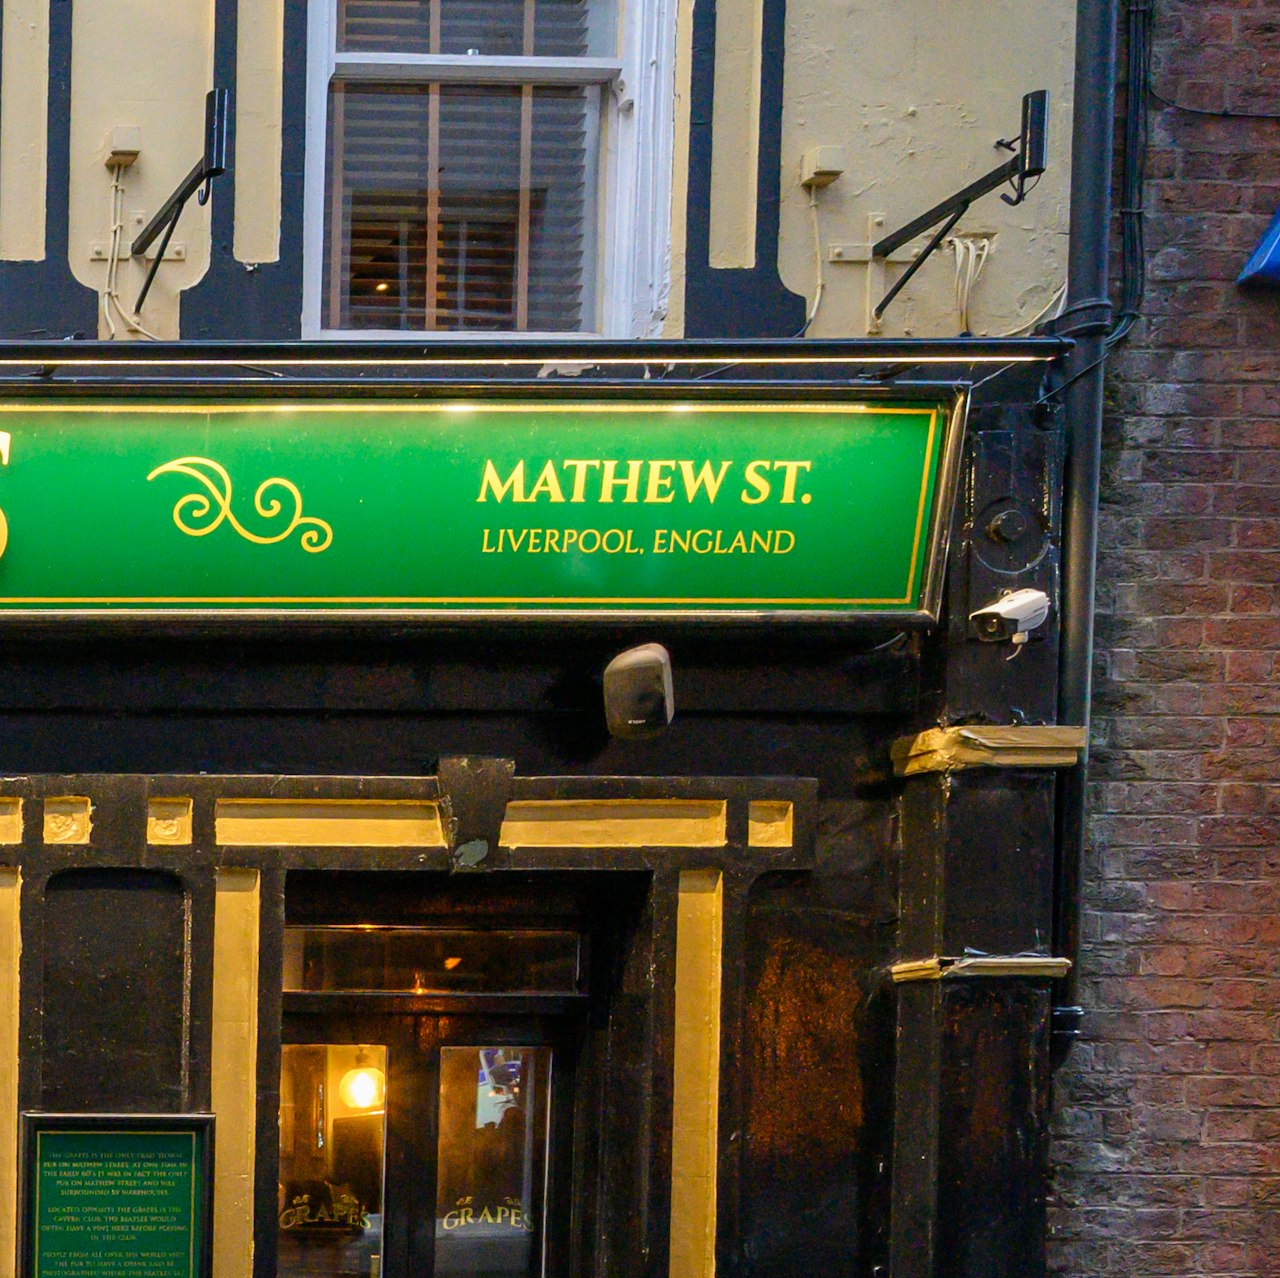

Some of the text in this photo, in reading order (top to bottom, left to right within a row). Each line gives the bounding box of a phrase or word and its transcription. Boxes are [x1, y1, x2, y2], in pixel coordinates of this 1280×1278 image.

[476, 459, 812, 504] MATHEW ST.
[482, 528, 796, 555] LIVERPOOL, ENGLAND
[279, 1204, 372, 1230] GRAPES
[443, 1205, 536, 1232] GRAPES
